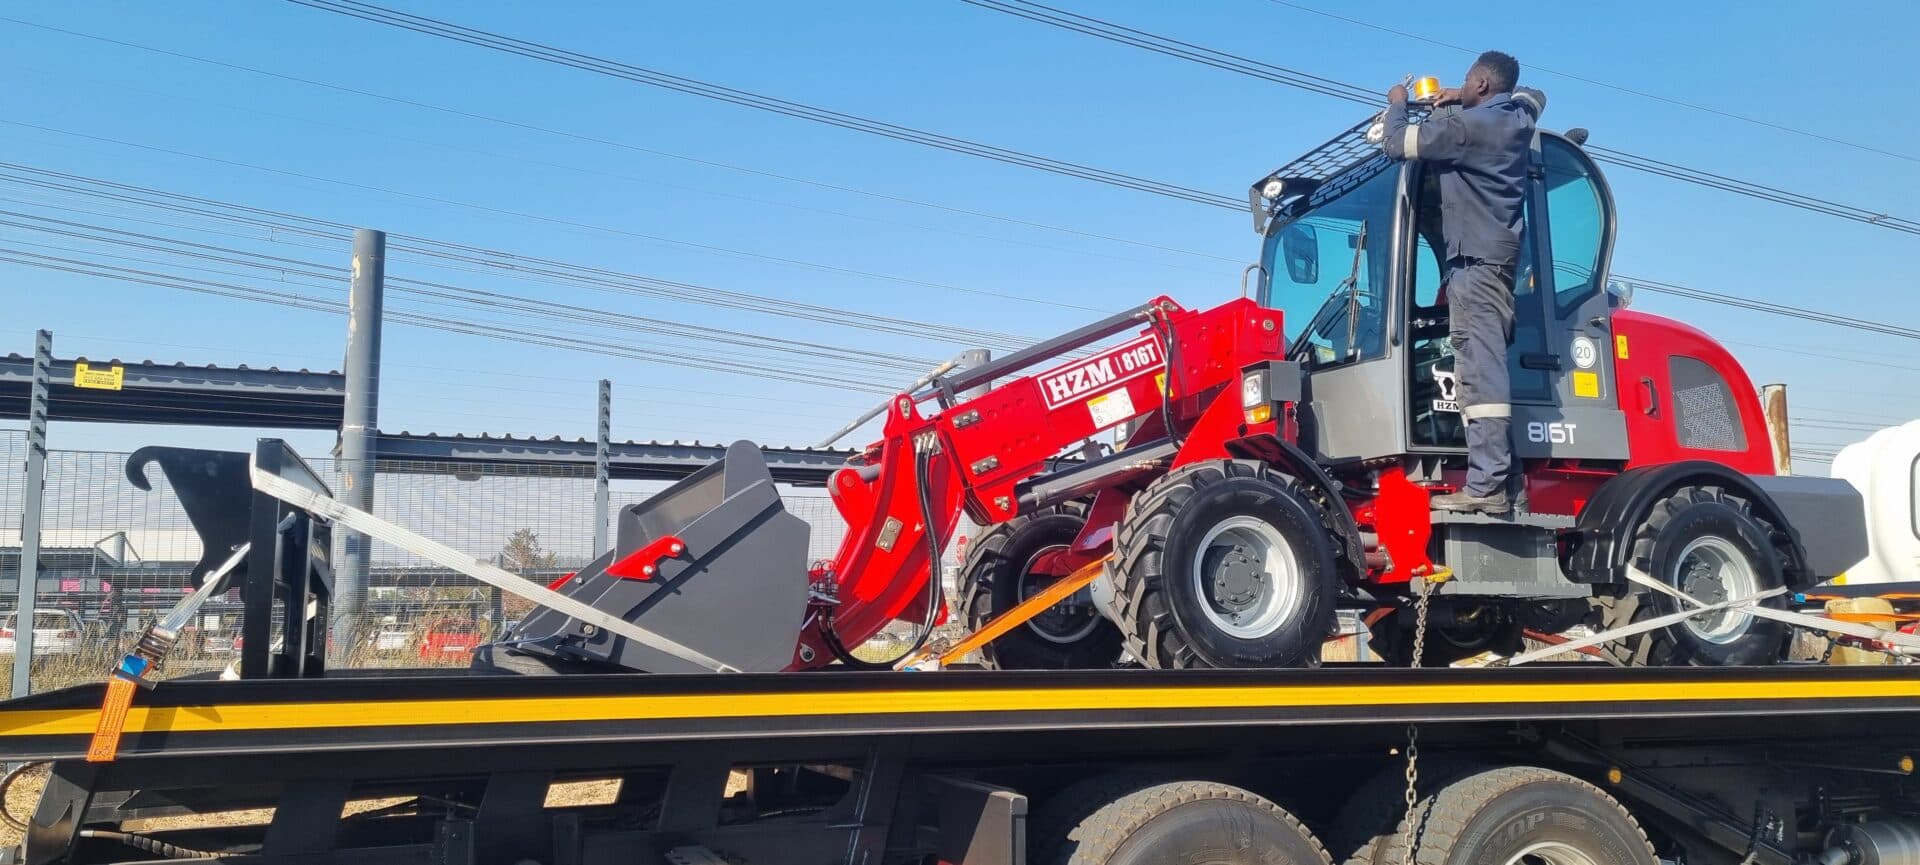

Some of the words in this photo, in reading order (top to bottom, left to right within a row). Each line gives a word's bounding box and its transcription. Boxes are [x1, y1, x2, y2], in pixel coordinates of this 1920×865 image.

[1575, 346, 1591, 359] 20
[1046, 358, 1116, 402] HZM
[1121, 343, 1157, 371] 816T
[1527, 422, 1577, 444] 816T
